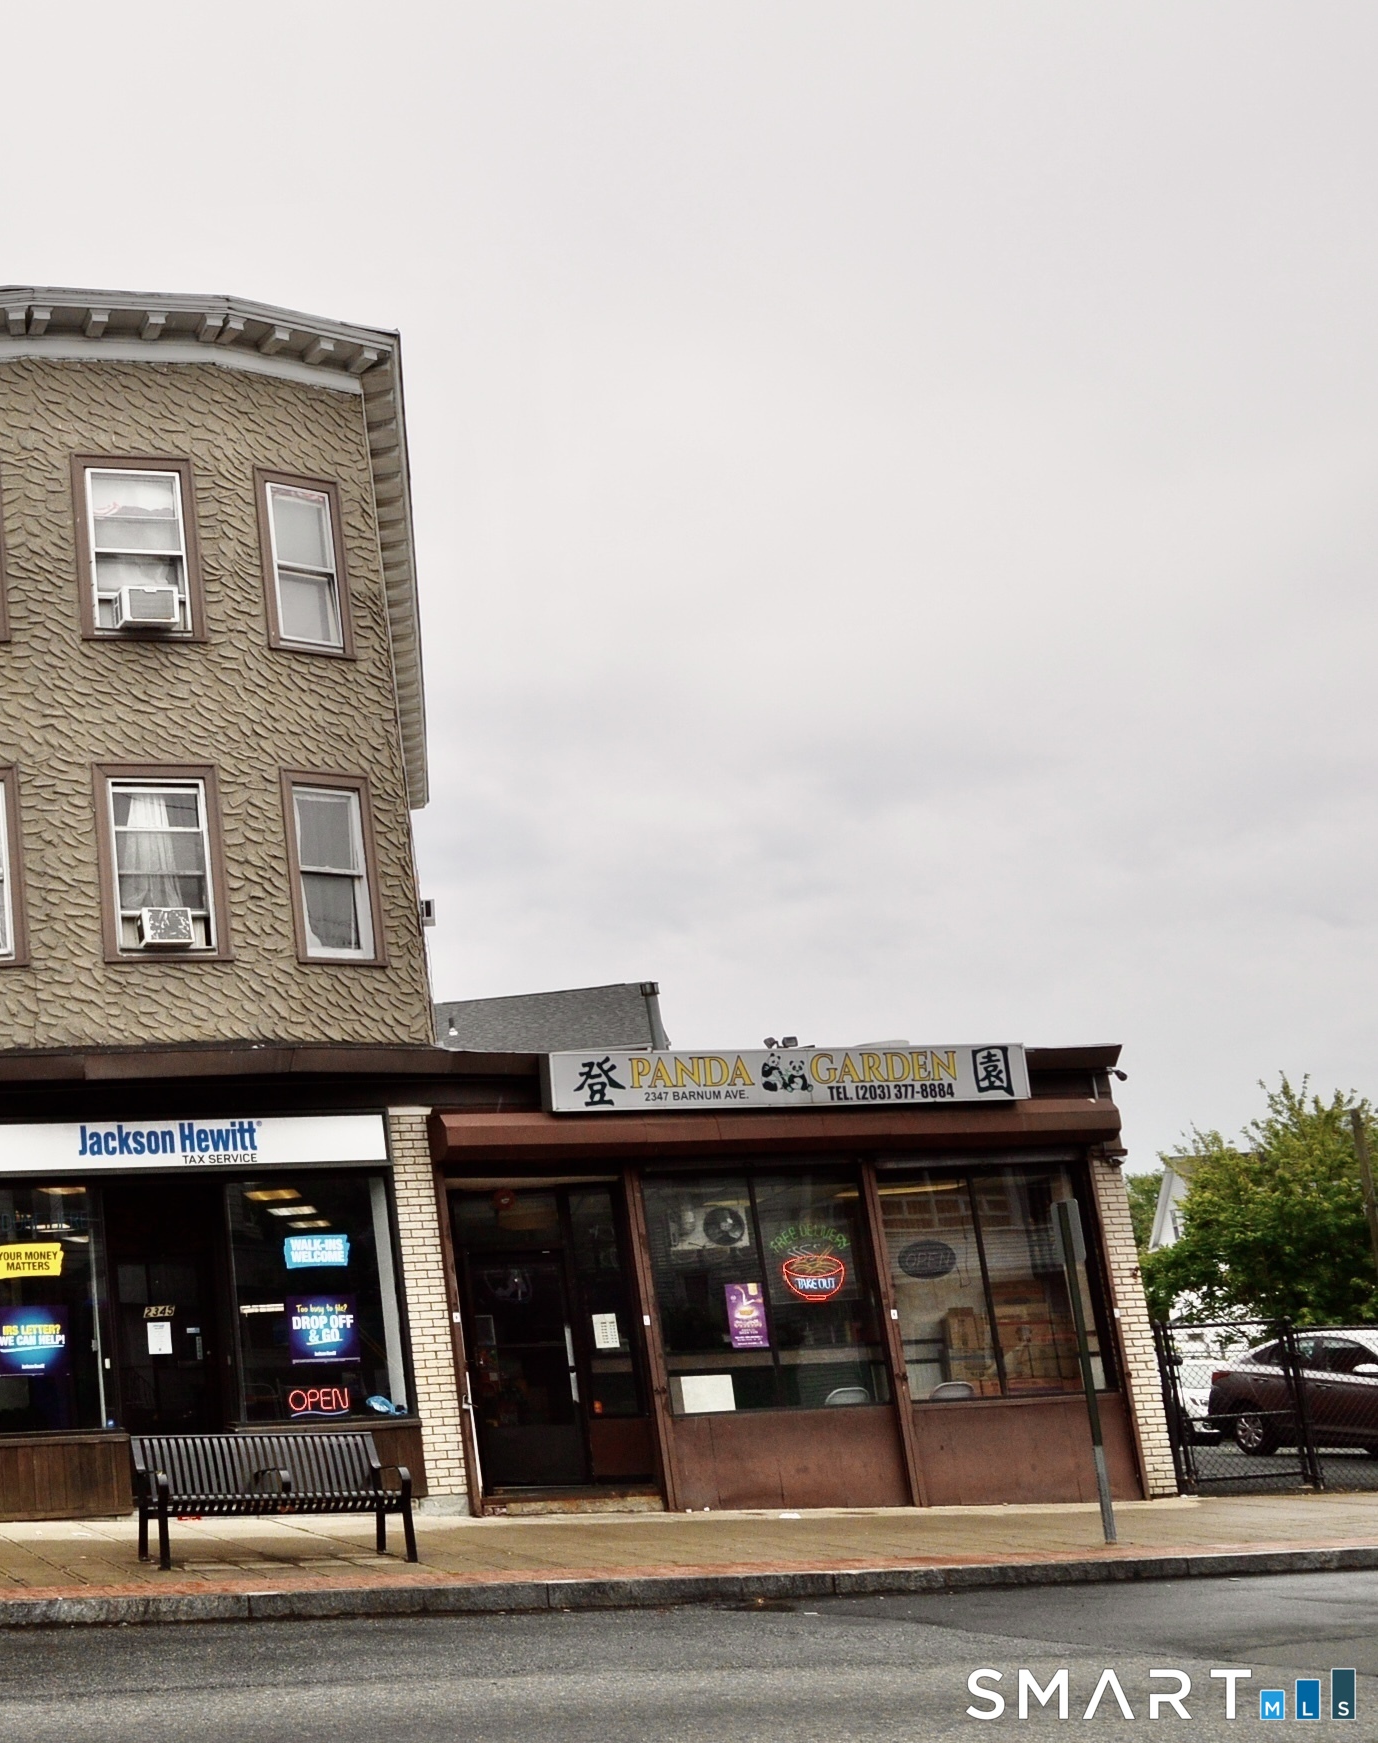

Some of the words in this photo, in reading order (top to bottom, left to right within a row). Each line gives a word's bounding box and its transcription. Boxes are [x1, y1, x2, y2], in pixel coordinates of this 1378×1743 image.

[628, 1055, 755, 1089] PANDA
[809, 1051, 957, 1084] GARDEN
[972, 1046, 1015, 1097] 園
[573, 1056, 626, 1107] 登
[644, 1091, 668, 1101] 2347
[672, 1090, 721, 1101] BARNUM
[724, 1089, 749, 1100] AVE.
[827, 1085, 853, 1101] TEL.
[855, 1084, 891, 1101] (203)
[894, 1083, 955, 1100] 377-8884
[78, 1125, 174, 1156] Jackson
[178, 1121, 258, 1153] Hewitt
[182, 1155, 205, 1165] TAX
[208, 1153, 258, 1164] SERVICE
[290, 1239, 344, 1250] WALK-INS
[769, 1226, 798, 1254] FREE
[798, 1224, 851, 1250] DELIVERY
[24, 1251, 58, 1261] MONEY
[291, 1250, 345, 1263] WELCOME
[906, 1252, 951, 1268] OPEN
[6, 1261, 51, 1271] MATTERS
[795, 1277, 817, 1289] TAKE
[818, 1277, 836, 1289] OUT
[145, 1305, 175, 1318] 2345
[296, 1304, 308, 1313] Too
[310, 1304, 325, 1315] busy
[326, 1304, 333, 1312] to
[335, 1303, 348, 1315] file?
[292, 1315, 328, 1330] DROP
[329, 1314, 354, 1329] OFF
[2, 1325, 19, 1336] IRS
[21, 1324, 61, 1335] LETTER?
[309, 1329, 320, 1342] &
[322, 1328, 340, 1342] GO
[16, 1335, 37, 1346] CAN
[38, 1334, 66, 1345] HELP!
[289, 1387, 349, 1411] OPEN
